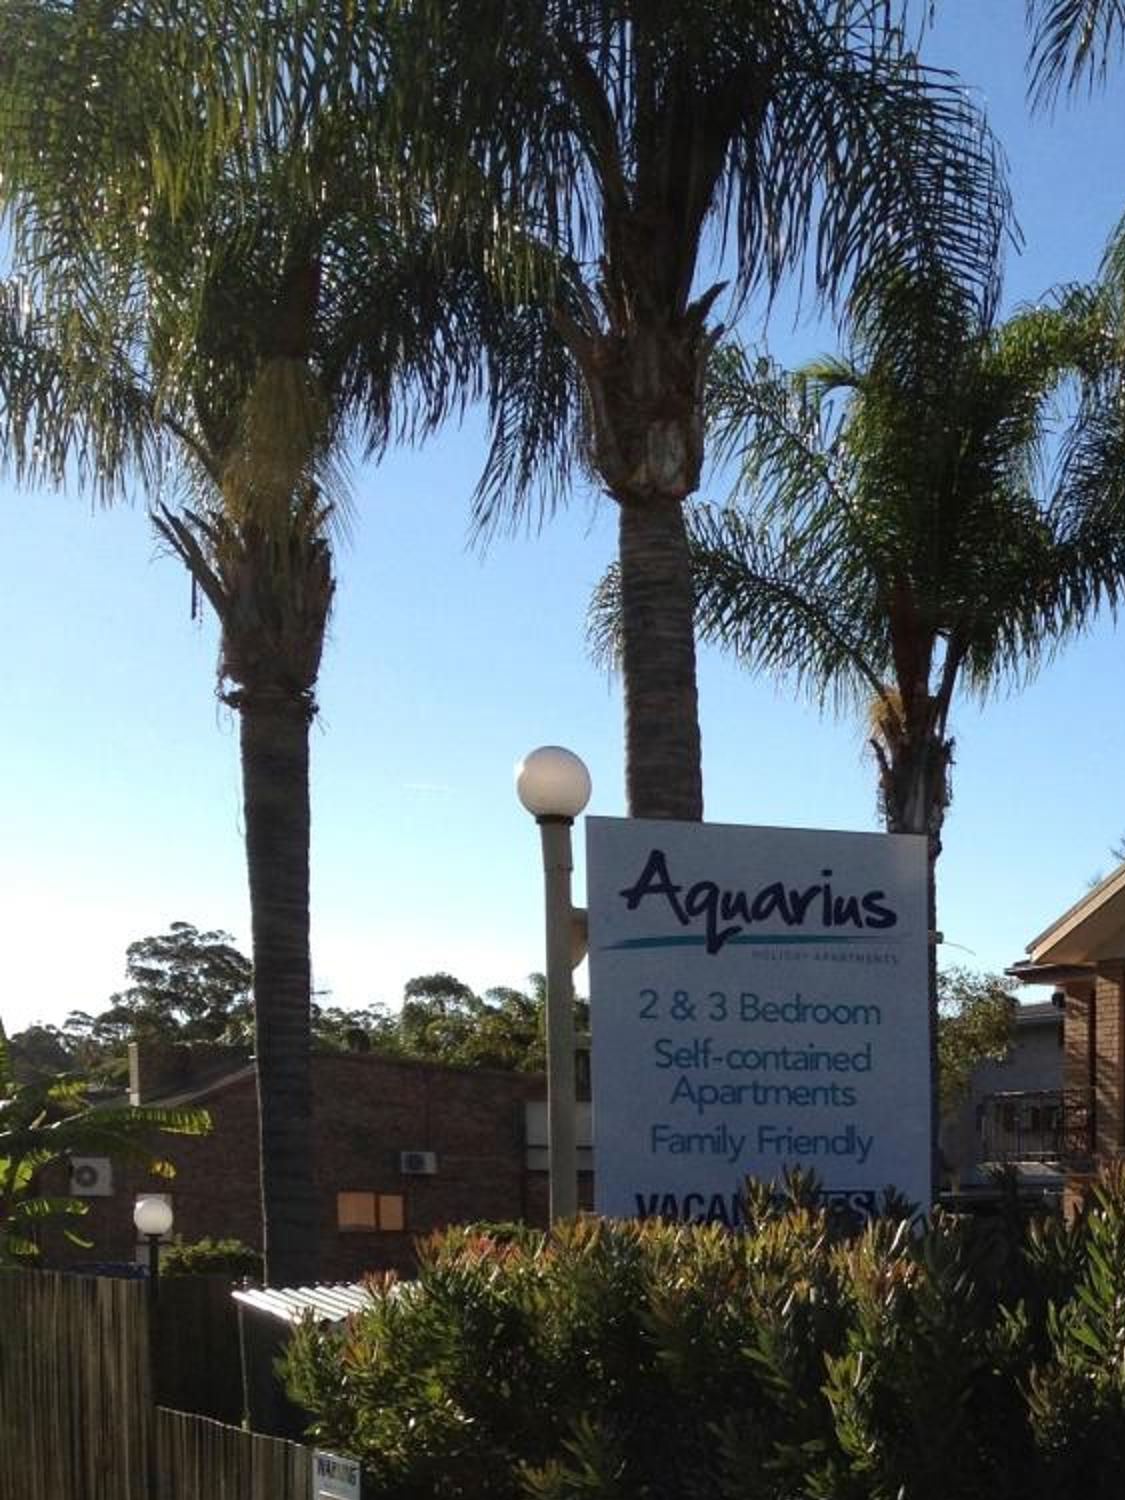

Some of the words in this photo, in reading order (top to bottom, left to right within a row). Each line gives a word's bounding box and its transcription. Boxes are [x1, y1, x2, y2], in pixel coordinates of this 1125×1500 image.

[619, 849, 898, 955] Aquarius
[813, 950, 899, 966] APARTMENTS
[638, 988, 659, 1020] 2
[670, 989, 697, 1022] &
[708, 991, 728, 1023] 3
[739, 993, 882, 1025] Bedroom
[654, 1038, 873, 1073] Self-contained
[670, 1075, 858, 1114] Apartments
[650, 1123, 747, 1163] Family
[757, 1124, 875, 1165] Friendly
